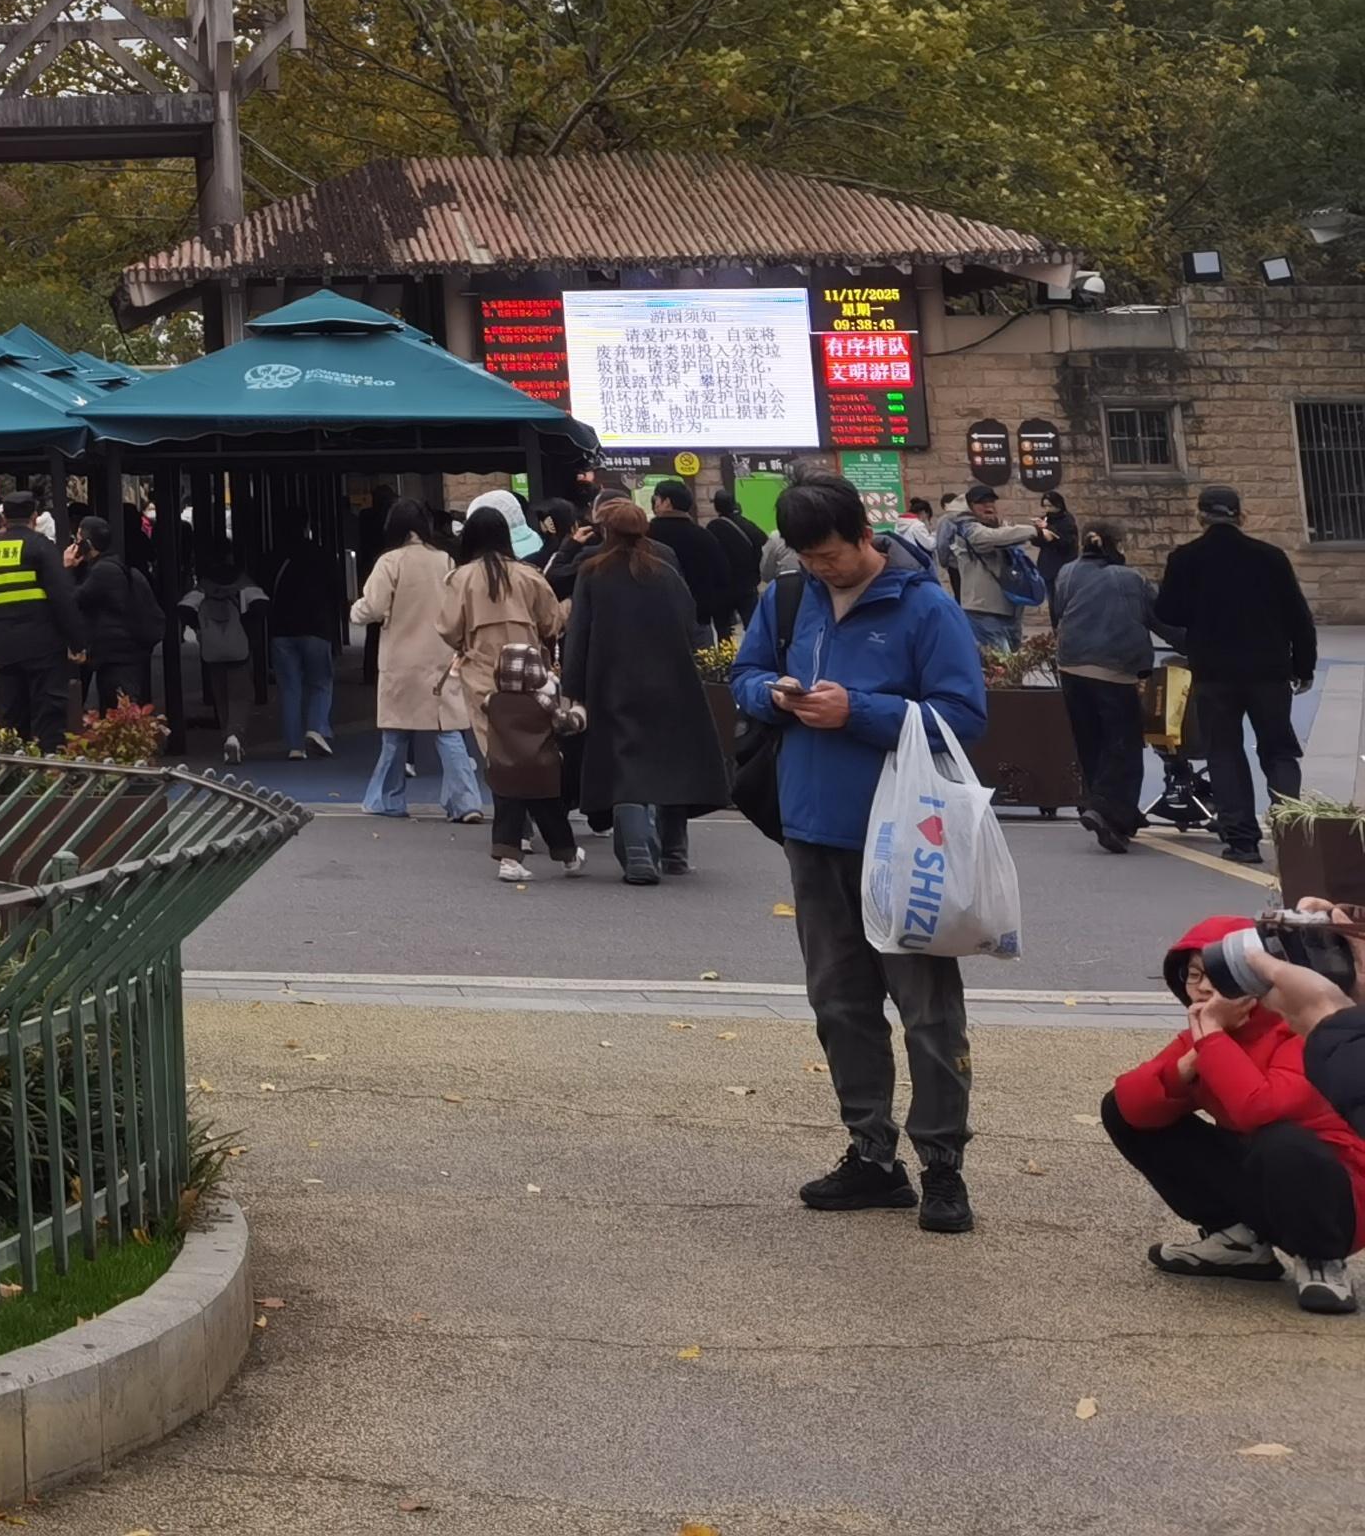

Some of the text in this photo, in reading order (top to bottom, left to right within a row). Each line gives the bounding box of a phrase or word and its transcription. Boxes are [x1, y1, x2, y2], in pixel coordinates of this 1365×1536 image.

[824, 288, 900, 302] 11/17/2025
[841, 302, 885, 317] 星期一
[833, 319, 895, 331] 09:38:43
[826, 337, 909, 357] 有序排队
[830, 361, 911, 382] 文明游园
[363, 379, 396, 387] ZOO
